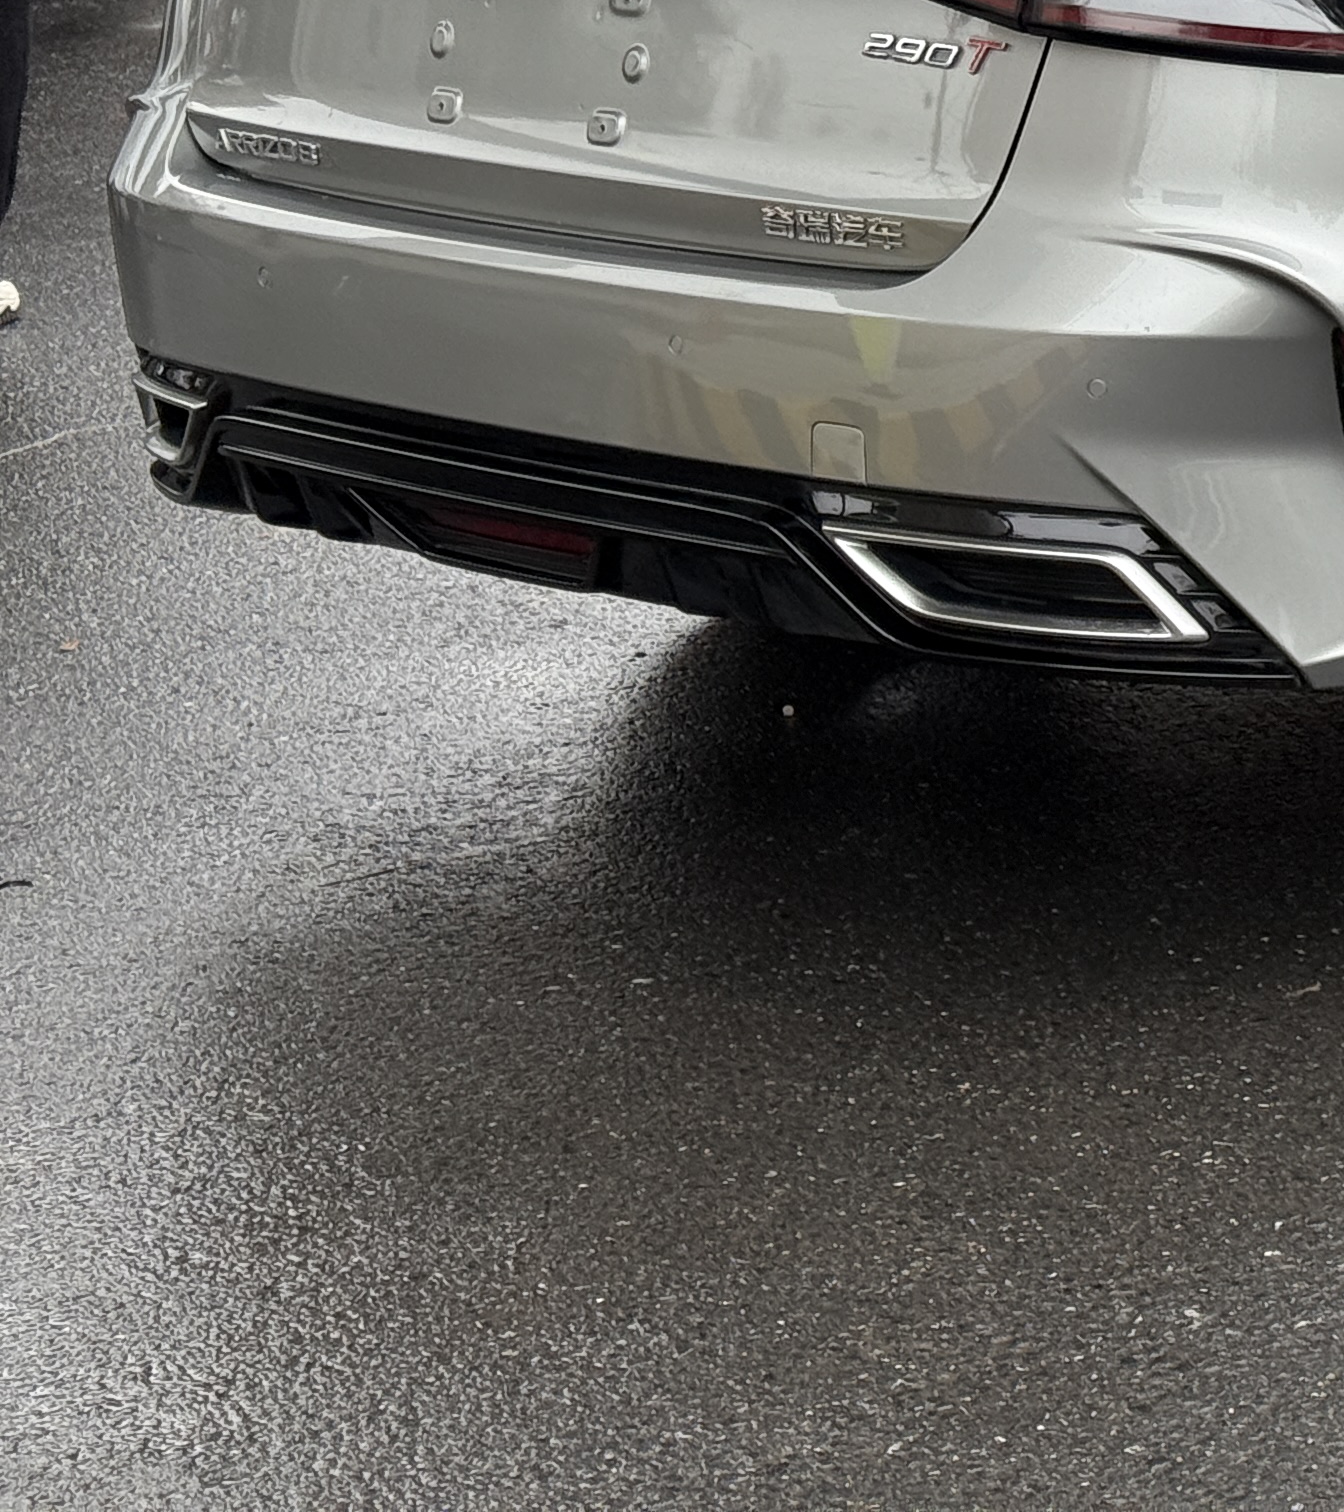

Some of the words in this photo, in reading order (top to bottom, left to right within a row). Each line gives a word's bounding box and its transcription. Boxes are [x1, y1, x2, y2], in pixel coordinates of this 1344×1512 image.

[862, 32, 1009, 75] 290T
[760, 204, 905, 250] 奇瑞汽车
